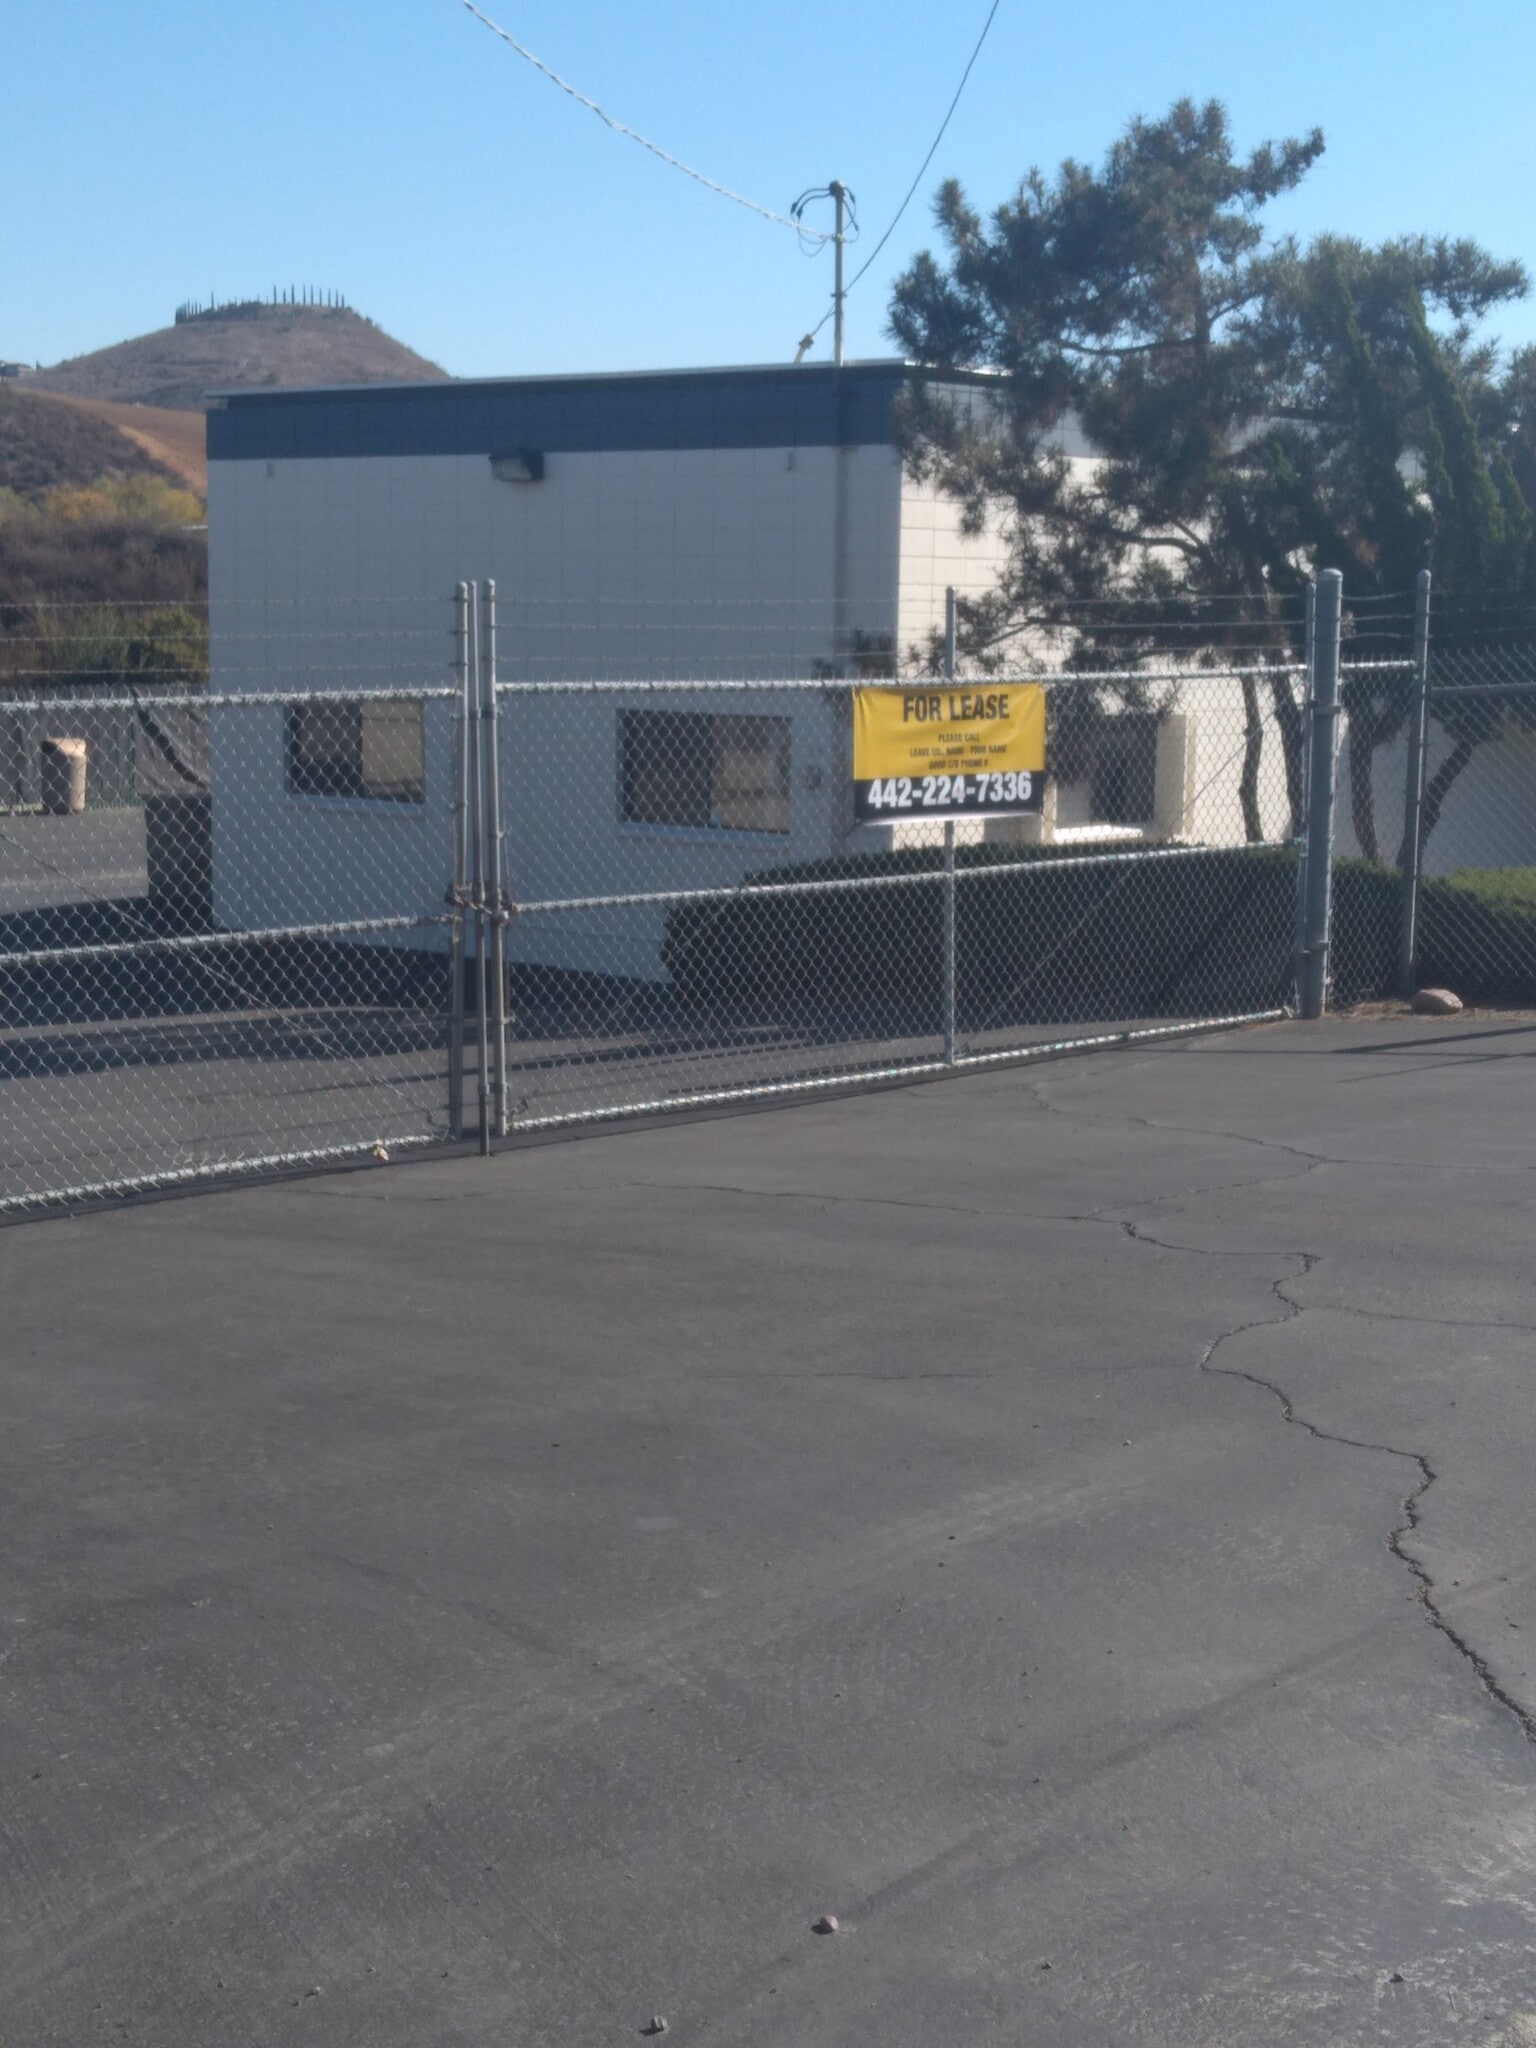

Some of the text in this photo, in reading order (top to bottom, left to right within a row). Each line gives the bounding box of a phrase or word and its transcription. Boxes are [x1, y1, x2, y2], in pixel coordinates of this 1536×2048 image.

[903, 694, 1010, 722] FOR LEASE
[868, 771, 1032, 809] 442-224-7336
